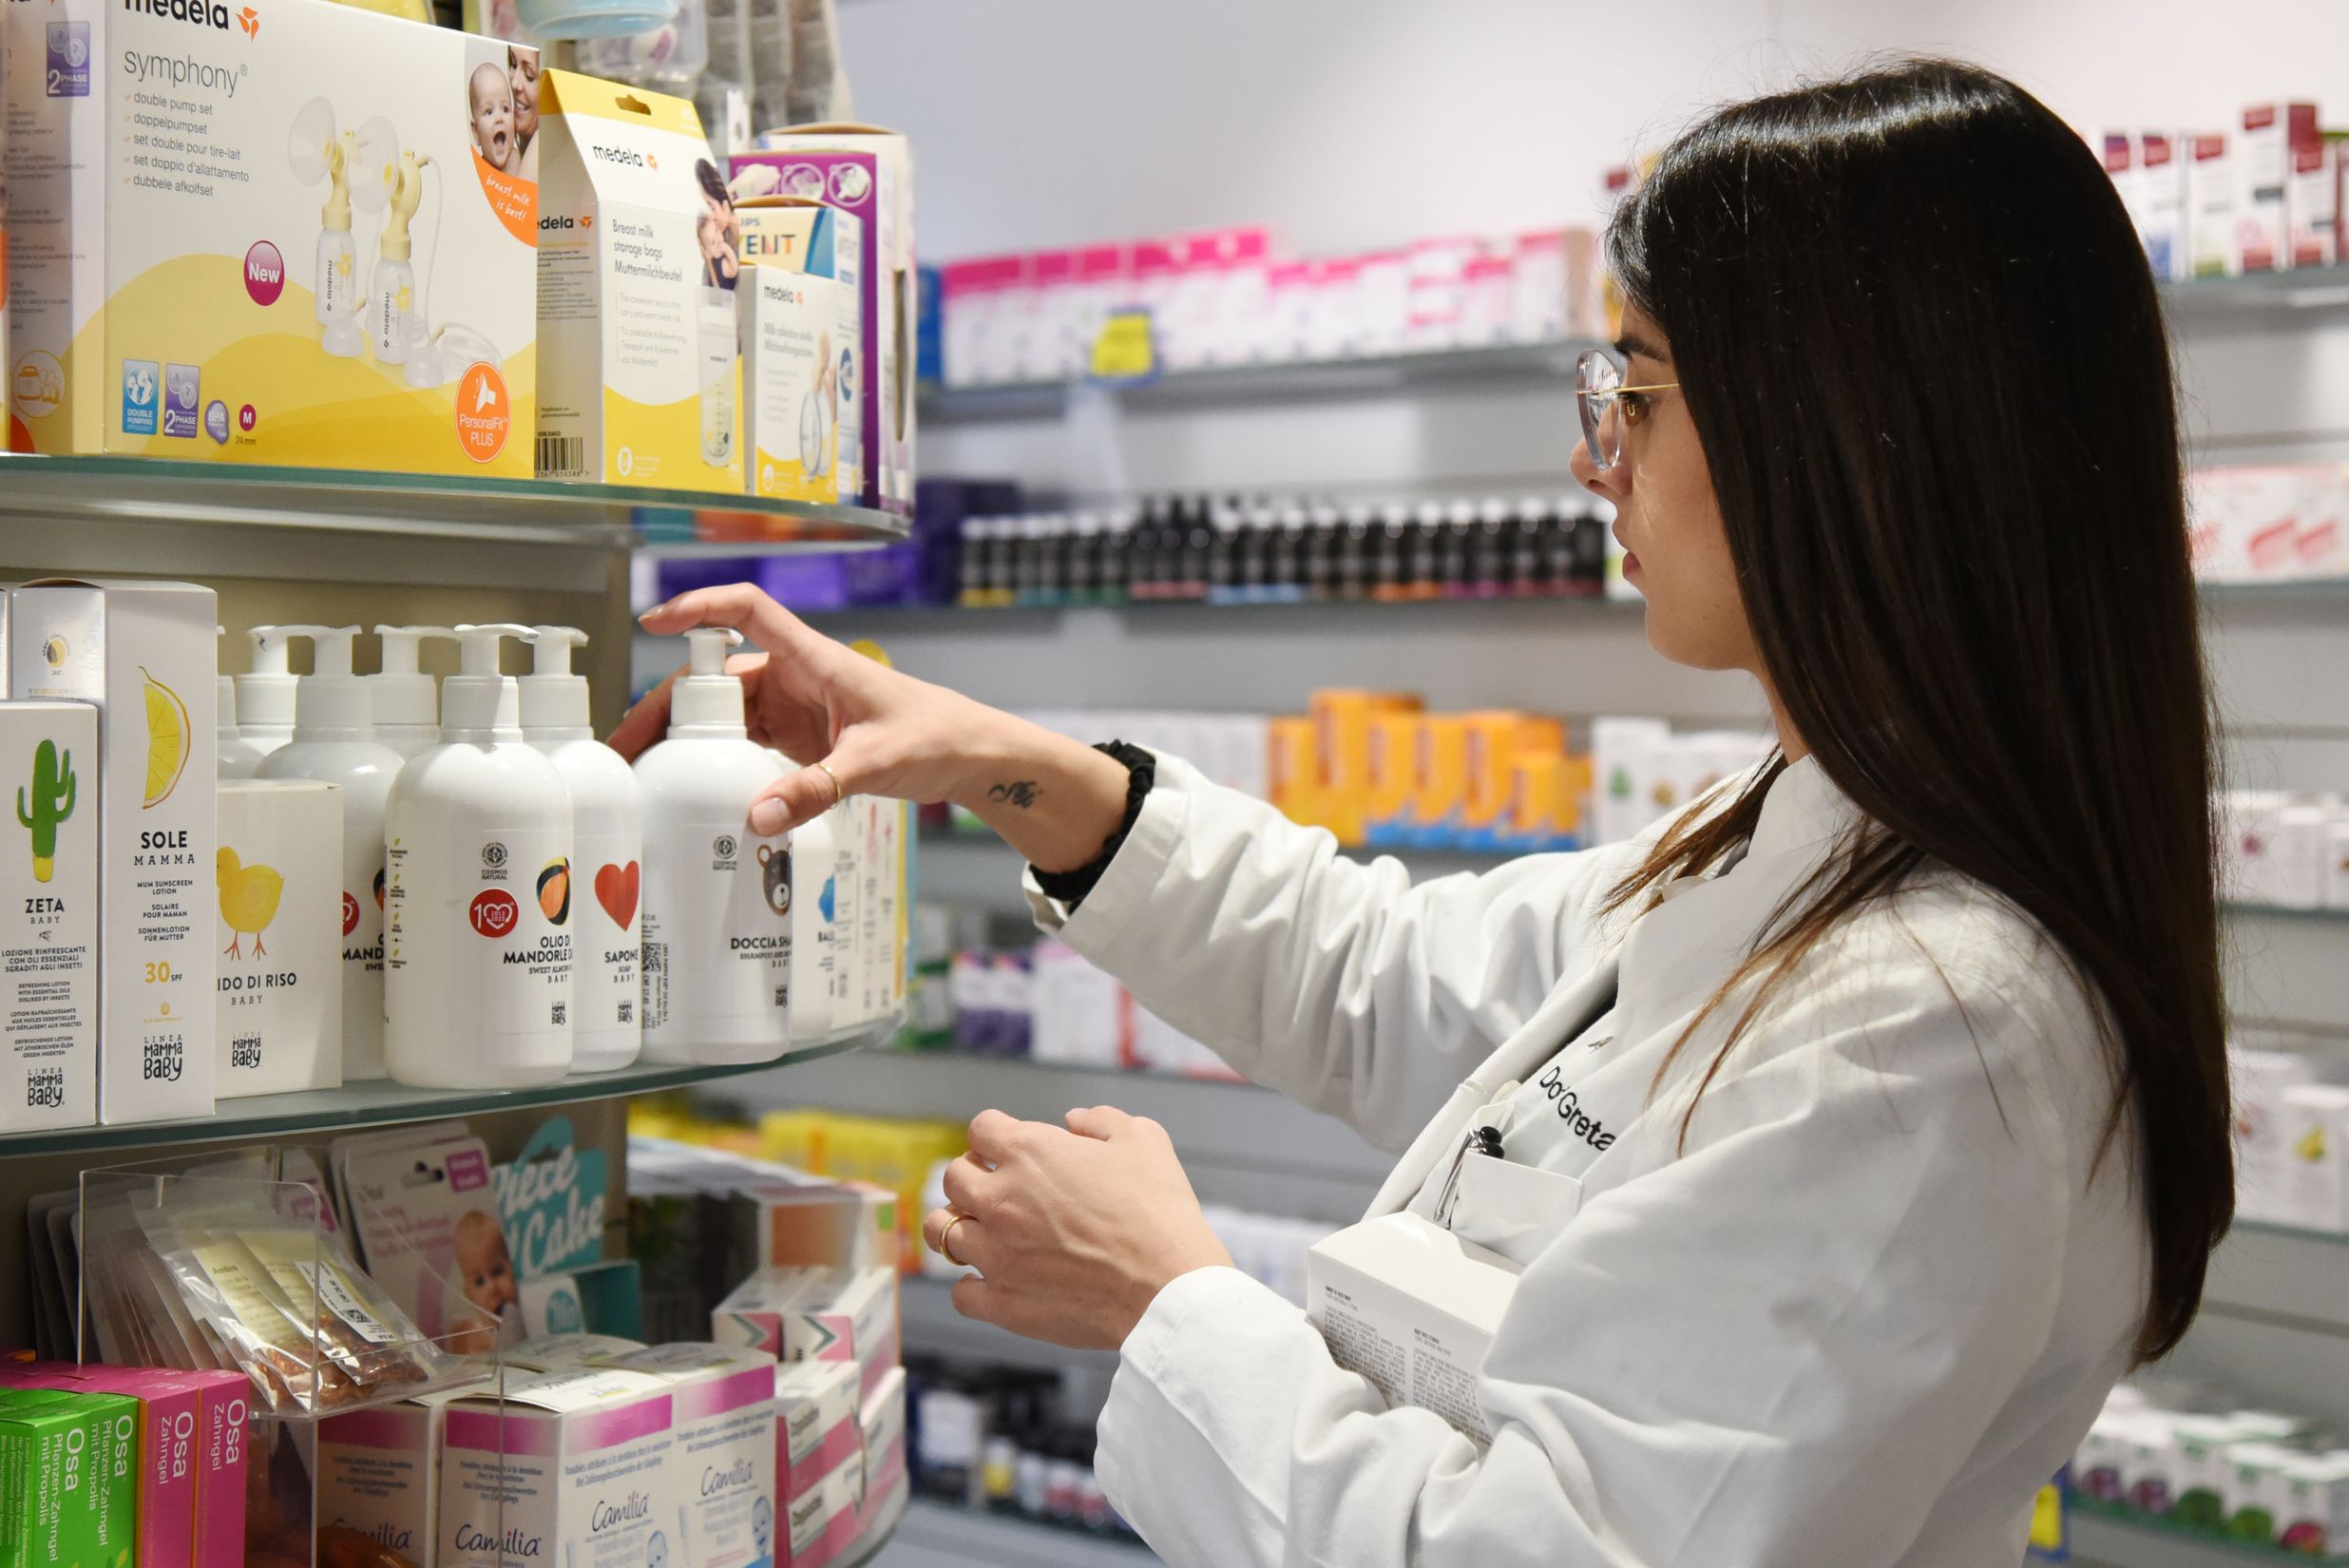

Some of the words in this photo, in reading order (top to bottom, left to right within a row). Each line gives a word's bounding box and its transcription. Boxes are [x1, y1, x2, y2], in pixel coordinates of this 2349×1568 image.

[48, 69, 61, 94] 2
[61, 74, 87, 83] PHASE
[134, 92, 167, 106] double
[170, 99, 196, 114] pump
[200, 104, 213, 115] set
[134, 112, 207, 135] doppelpumpset
[133, 134, 148, 145] set
[151, 136, 183, 152] double
[186, 143, 207, 158] pour
[210, 145, 240, 161] tire-lait
[592, 145, 643, 168] medela
[133, 154, 148, 166] set
[151, 157, 184, 175] doppio
[187, 163, 249, 182] d'allattamento
[133, 175, 173, 192] dubbele
[175, 182, 213, 197] afkolfset
[486, 174, 513, 197] breast
[496, 199, 505, 210] is
[537, 216, 574, 229] dela
[613, 220, 637, 237] Breast
[639, 225, 654, 239] milk
[614, 240, 642, 258] storage
[644, 244, 663, 261] bags
[248, 261, 280, 284] New
[615, 259, 682, 281] Muttermilchbeutel
[764, 285, 794, 303] medela
[127, 410, 152, 418] DOUBLE
[164, 410, 176, 433] 2
[175, 415, 197, 425] PHASE
[208, 411, 225, 423] BPA
[243, 411, 252, 425] M
[235, 436, 243, 445] 24
[244, 438, 256, 447] mm
[470, 431, 493, 447] PLUS
[141, 831, 187, 849] SOLE
[134, 853, 195, 866] MAMMA
[26, 898, 65, 913] ZETA
[30, 915, 60, 925] BABY
[2, 948, 33, 957] LOZIONE
[35, 946, 86, 956] RINFRESCANTE
[540, 935, 564, 948] OLIO
[731, 936, 777, 950] DOCCIA
[503, 949, 567, 964] MANDORLE
[604, 949, 638, 964] SAPONE
[144, 961, 170, 984] 30
[247, 975, 260, 989] DI
[266, 972, 296, 987] RISO
[528, 966, 551, 975] SWEET
[547, 974, 568, 984] BABY
[613, 974, 635, 984] BABY
[231, 995, 262, 1005] BABY
[14, 1037, 53, 1045] ERFRISCHENDE
[143, 1034, 182, 1043] LINEA
[28, 1067, 63, 1076] LINEA
[211, 1403, 224, 1471] Zahngel
[226, 1398, 246, 1464] Osa
[114, 1415, 133, 1478] Osa
[158, 1415, 172, 1484] Zahngel
[173, 1411, 194, 1478] Osa
[65, 1428, 85, 1491] Osa
[89, 1452, 100, 1511] Propolis
[99, 1420, 112, 1546] Pflanzen-Zahngel
[700, 1458, 754, 1497] Camilia
[40, 1465, 50, 1526] Propolis
[48, 1433, 64, 1562] Pflanzen-Zahngel
[591, 1491, 650, 1532] Camilia
[455, 1523, 542, 1557] Camilia
